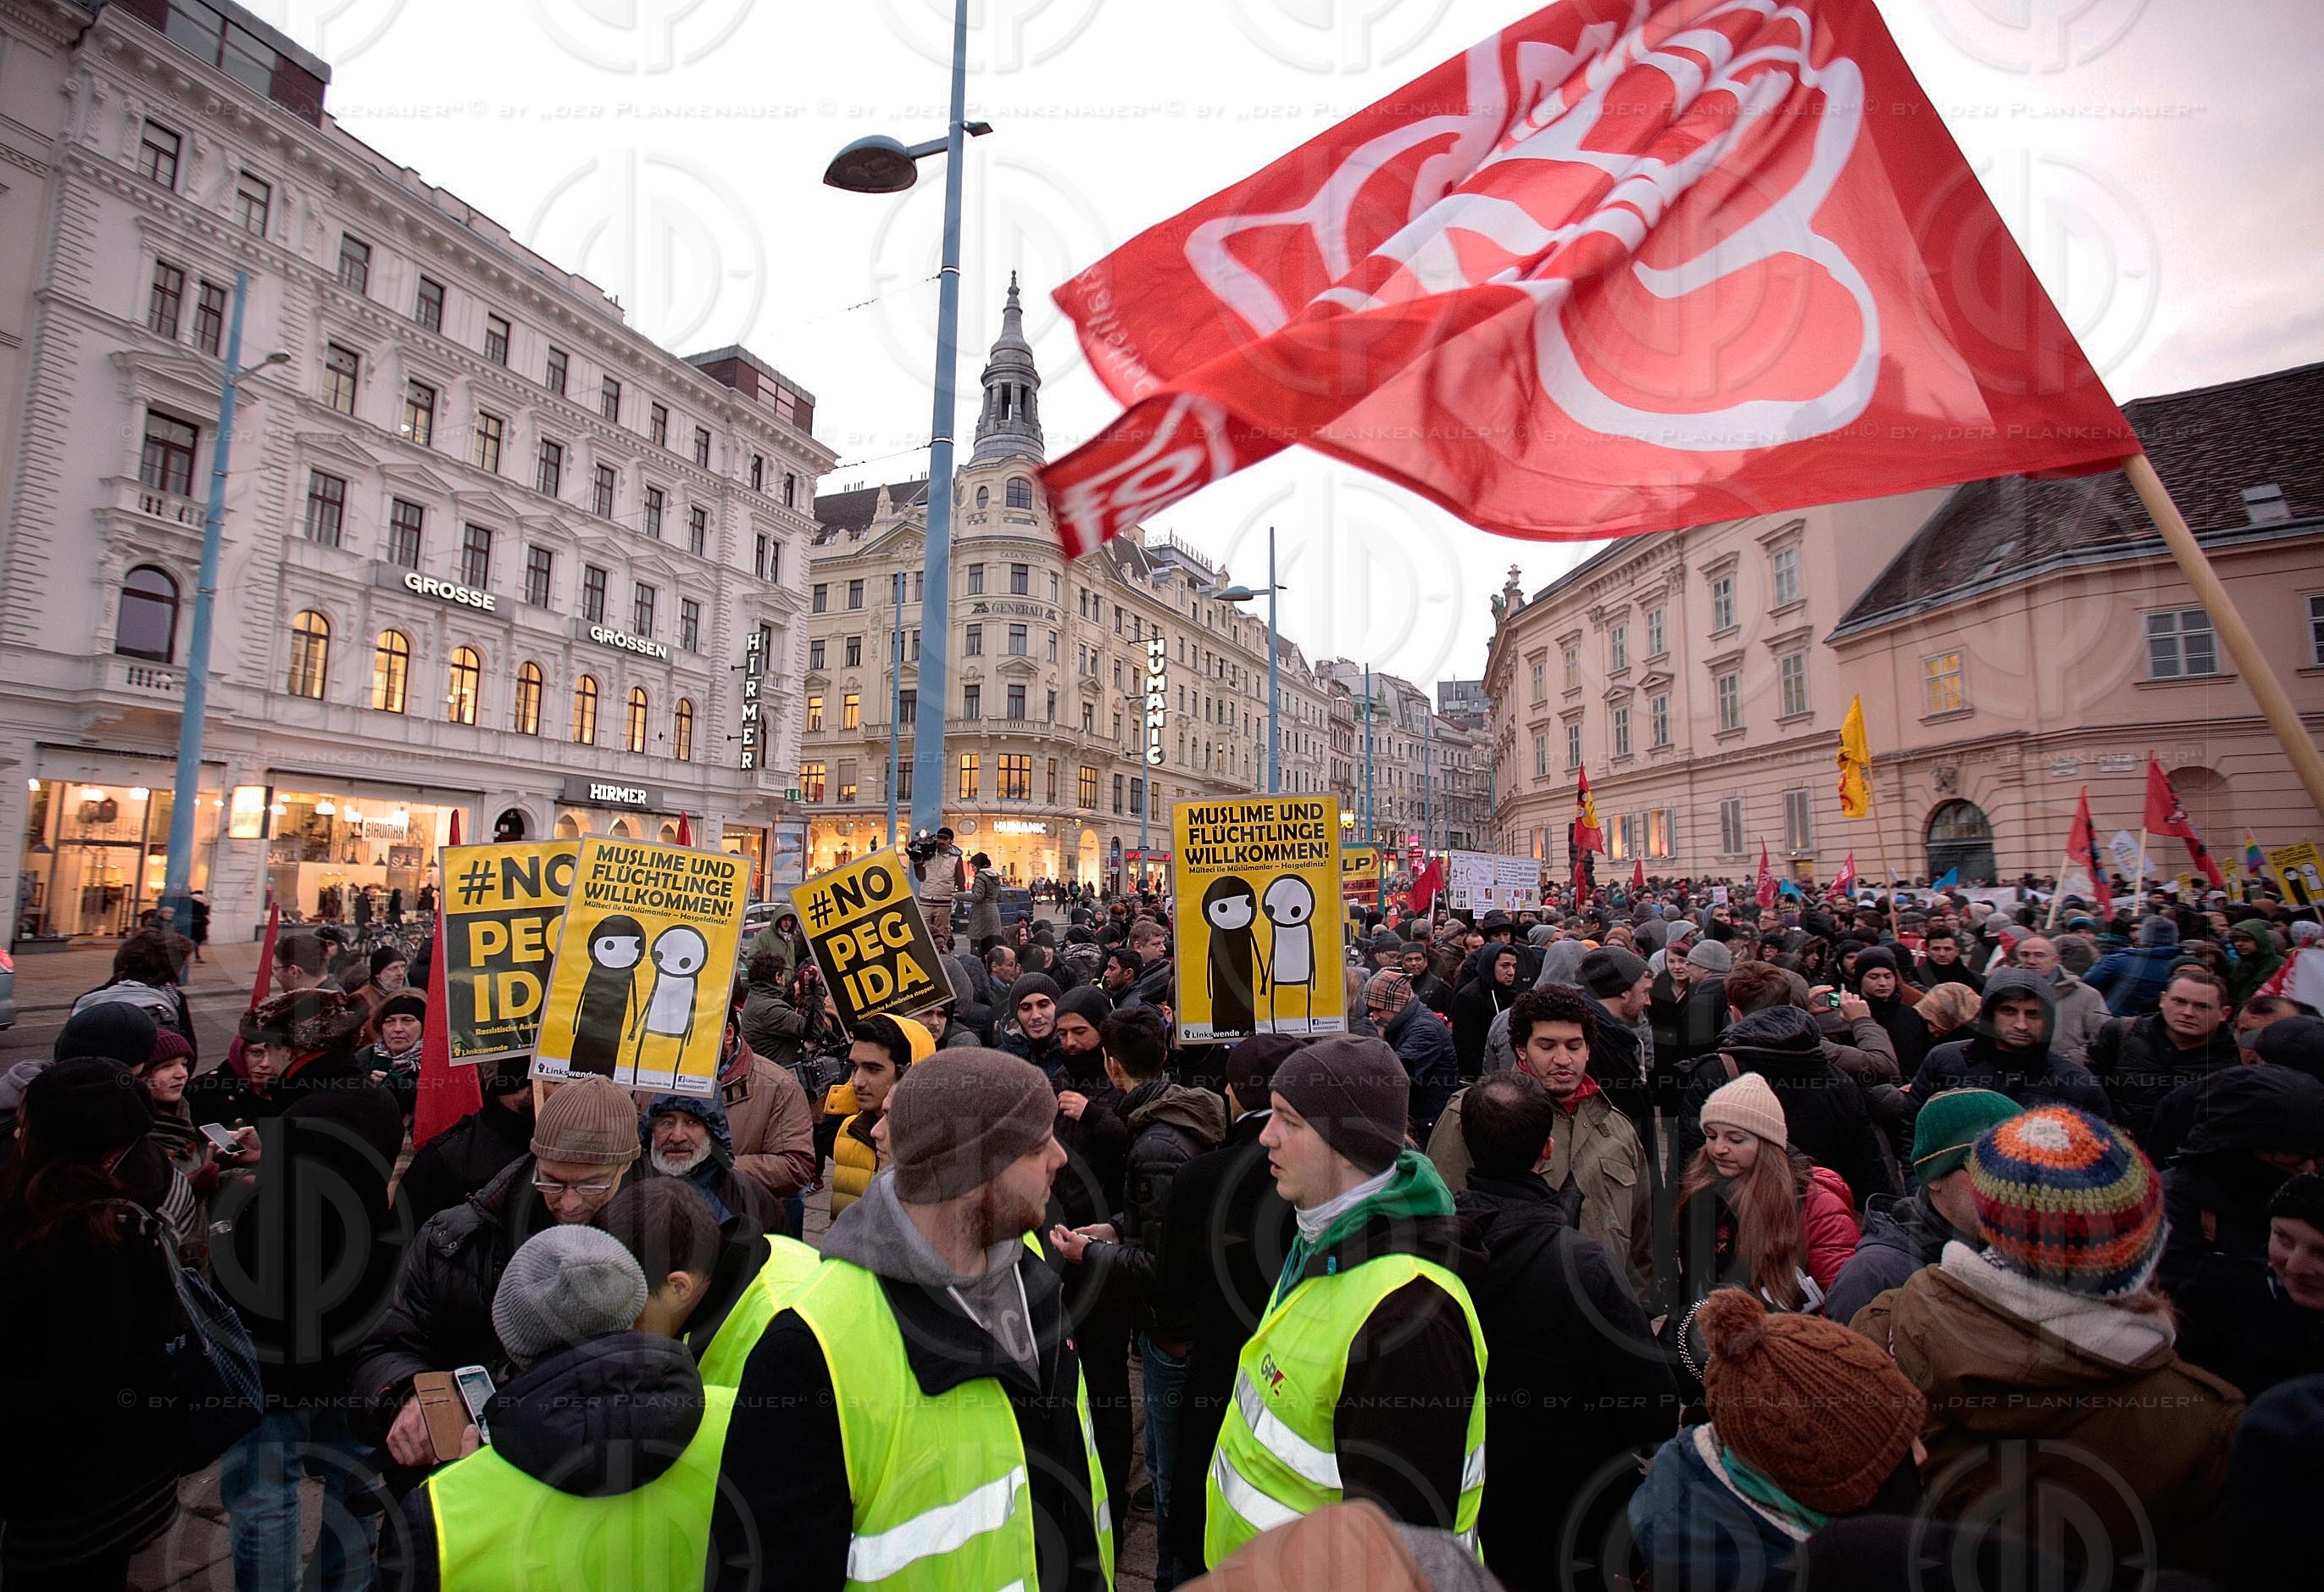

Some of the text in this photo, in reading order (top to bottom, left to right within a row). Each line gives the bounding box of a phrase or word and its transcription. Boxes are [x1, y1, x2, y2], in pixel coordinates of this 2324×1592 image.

[404, 572, 496, 611] GROSSE
[992, 603, 1042, 617] GENERALI
[590, 626, 667, 659] GRÖSSEN
[741, 633, 761, 769] HIRMER
[1146, 638, 1167, 765] HUMANIC
[590, 783, 648, 804] HIRMER
[993, 821, 1047, 834] HUMANIC
[1187, 805, 1275, 826] MUSLIME
[1279, 803, 1324, 821] UND
[1188, 822, 1325, 845] FLÜCHTLINGE
[596, 844, 736, 878] MUSLIME UND
[1185, 842, 1330, 866] WILLKOMMEN!
[1342, 856, 1371, 872] LP
[458, 853, 579, 905] #NO
[592, 863, 734, 898] FLÜCHTLINGE
[1343, 880, 1376, 890] w.slp.at
[584, 882, 734, 917] WILLKOMMEN!
[808, 866, 893, 929] #NO
[826, 911, 915, 972] PEG
[474, 971, 542, 1023] ID
[842, 950, 931, 1011] IDA
[519, 1022, 539, 1031] Aufm
[1192, 1029, 1240, 1039] Linkswende
[546, 1066, 597, 1078] Linkswend
